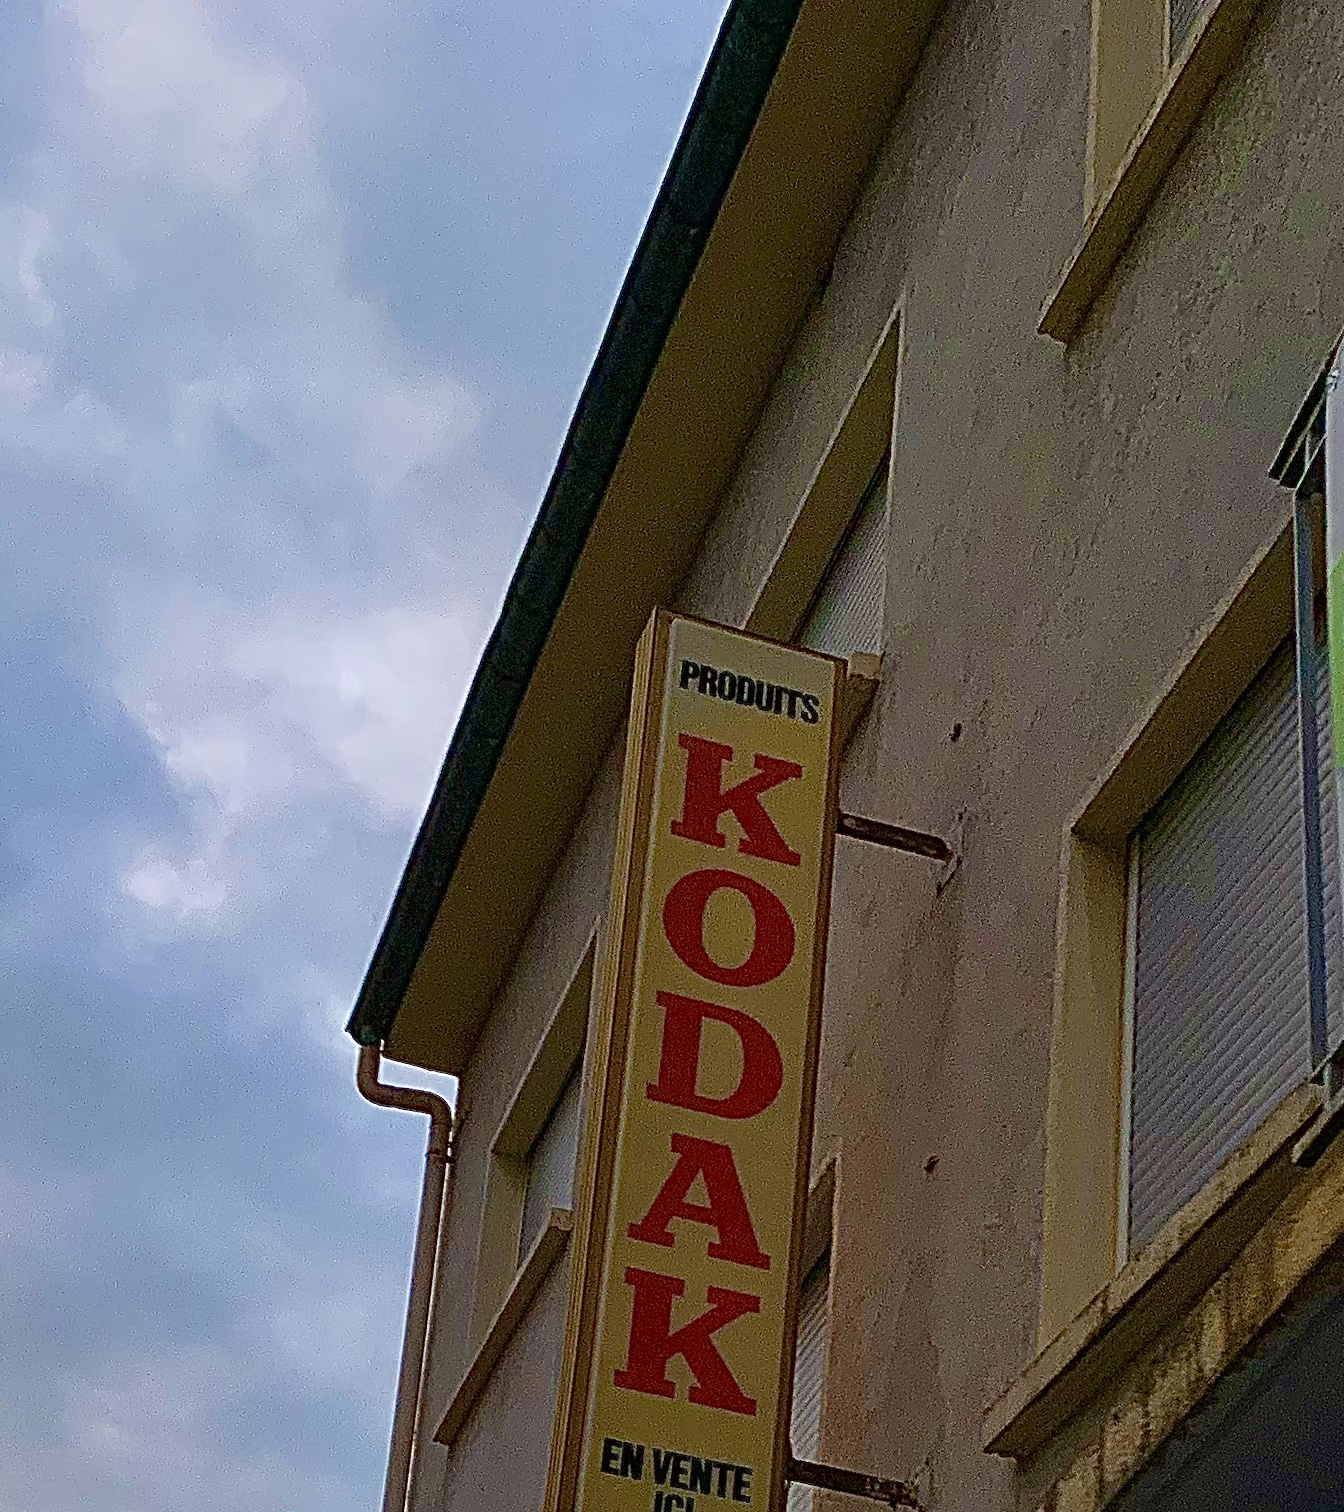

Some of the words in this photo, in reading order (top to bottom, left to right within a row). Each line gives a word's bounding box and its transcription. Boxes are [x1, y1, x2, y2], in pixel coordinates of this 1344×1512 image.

[678, 658, 821, 725] PRODUITS
[612, 732, 803, 1418] KODAK
[600, 1437, 646, 1481] EN
[652, 1447, 755, 1504] VENTE
